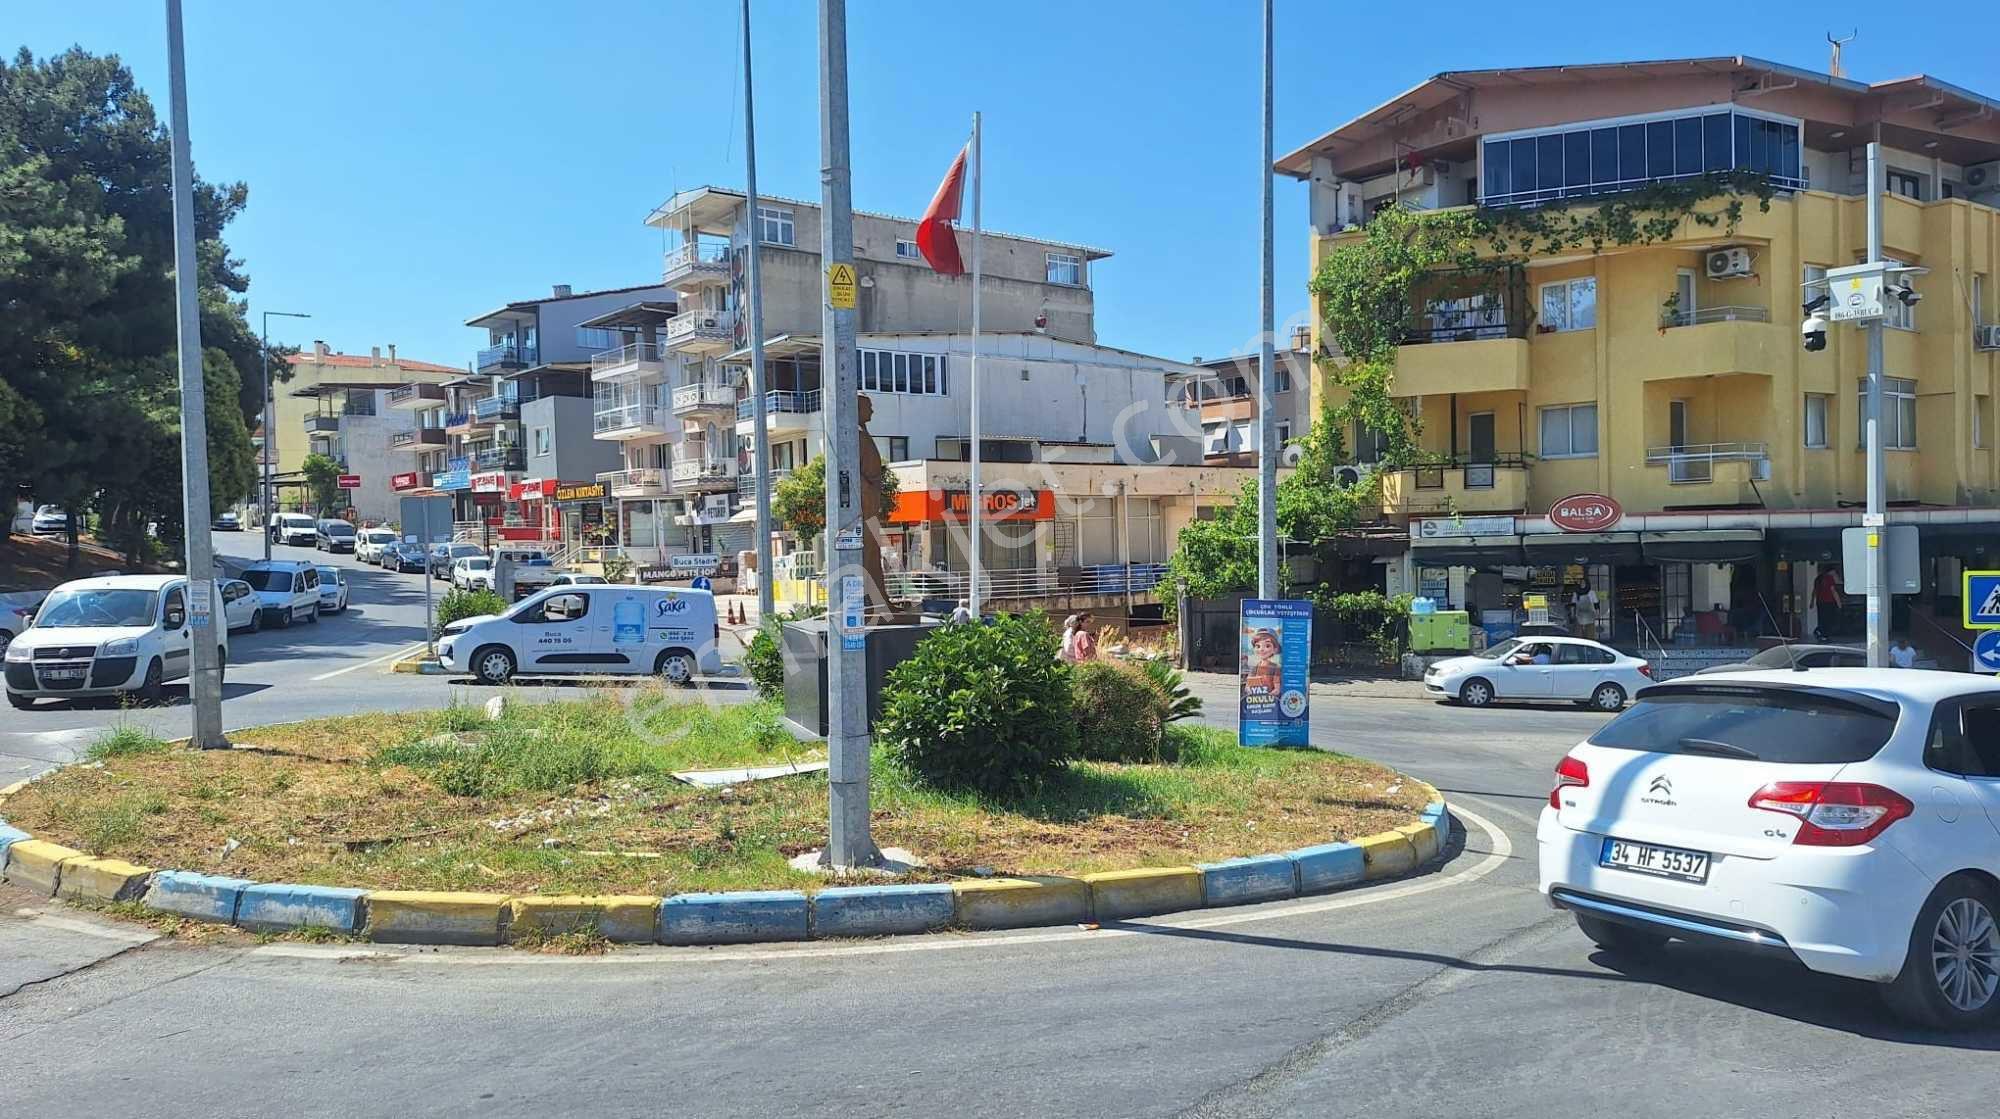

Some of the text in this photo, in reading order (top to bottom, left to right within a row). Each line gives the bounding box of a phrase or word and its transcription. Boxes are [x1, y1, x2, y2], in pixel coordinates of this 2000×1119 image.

[1560, 506, 1602, 517] BALSA
[673, 558, 692, 566] Buca
[643, 569, 677, 579] MANGO
[1246, 695, 1276, 704] OKULU
[1611, 842, 1630, 863] 34
[1637, 845, 1656, 867] HF
[1661, 849, 1705, 874] 5537
